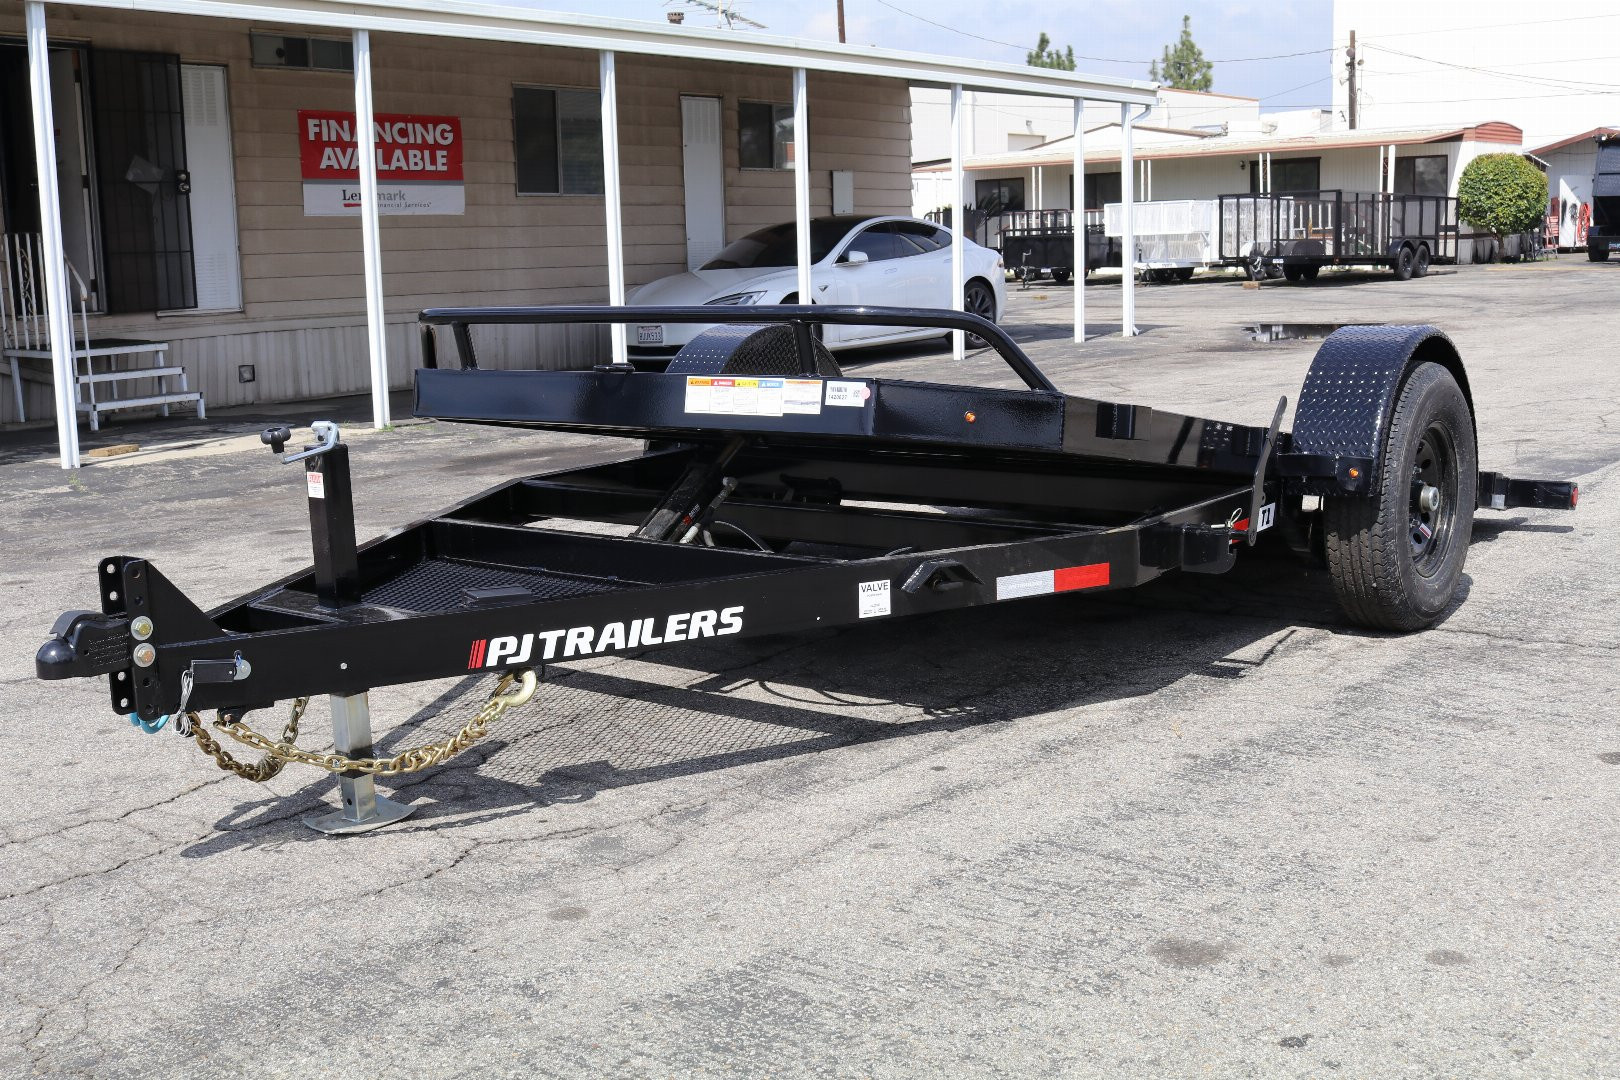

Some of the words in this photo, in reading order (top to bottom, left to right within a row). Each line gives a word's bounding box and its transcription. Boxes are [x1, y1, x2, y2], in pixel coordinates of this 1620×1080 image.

[307, 118, 454, 146] FINNCING
[319, 147, 448, 171] AVALABLE
[860, 581, 889, 593] VALVE
[485, 633, 534, 667] PJ
[538, 605, 745, 660] TRAILERS
